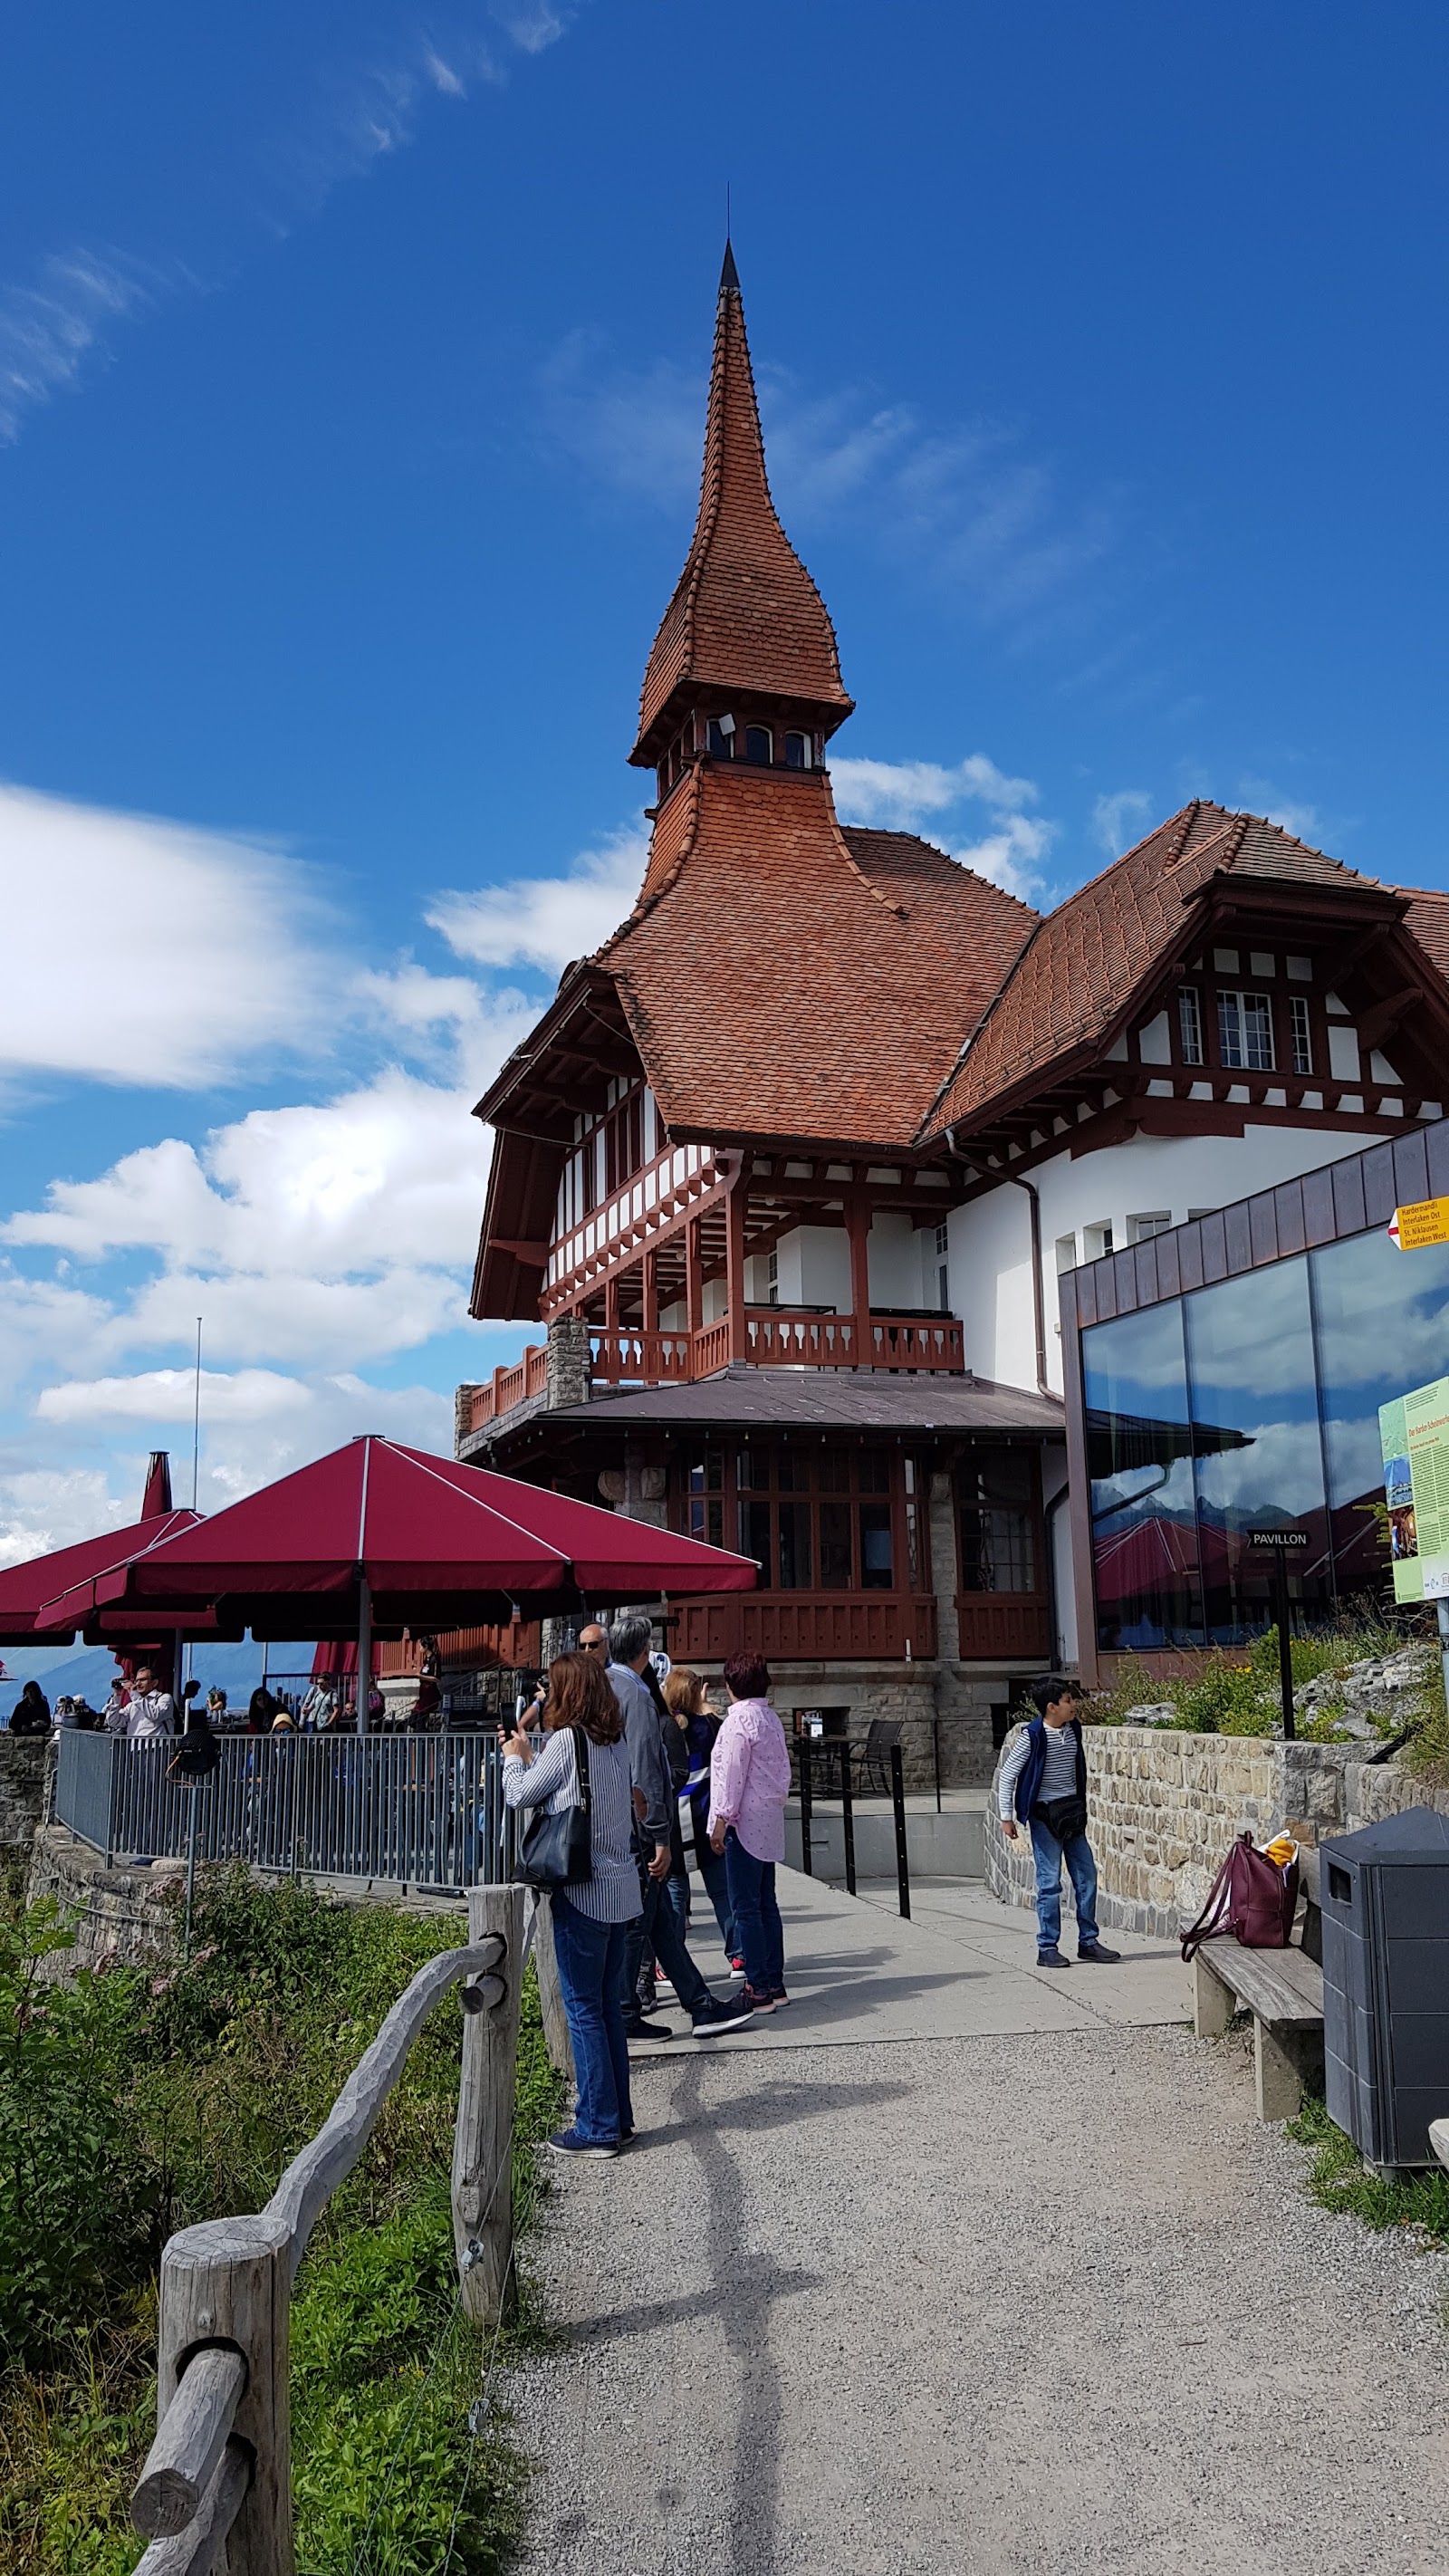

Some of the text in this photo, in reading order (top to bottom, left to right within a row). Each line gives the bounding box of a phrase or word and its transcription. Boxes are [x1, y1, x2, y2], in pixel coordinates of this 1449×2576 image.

[1402, 1201, 1437, 1216] Hardermandli
[1403, 1215, 1429, 1226] Interlaken
[1412, 1224, 1438, 1235] Niklausen
[1406, 1232, 1446, 1246] Interlaken West
[1253, 1533, 1307, 1544] PAVILLON
